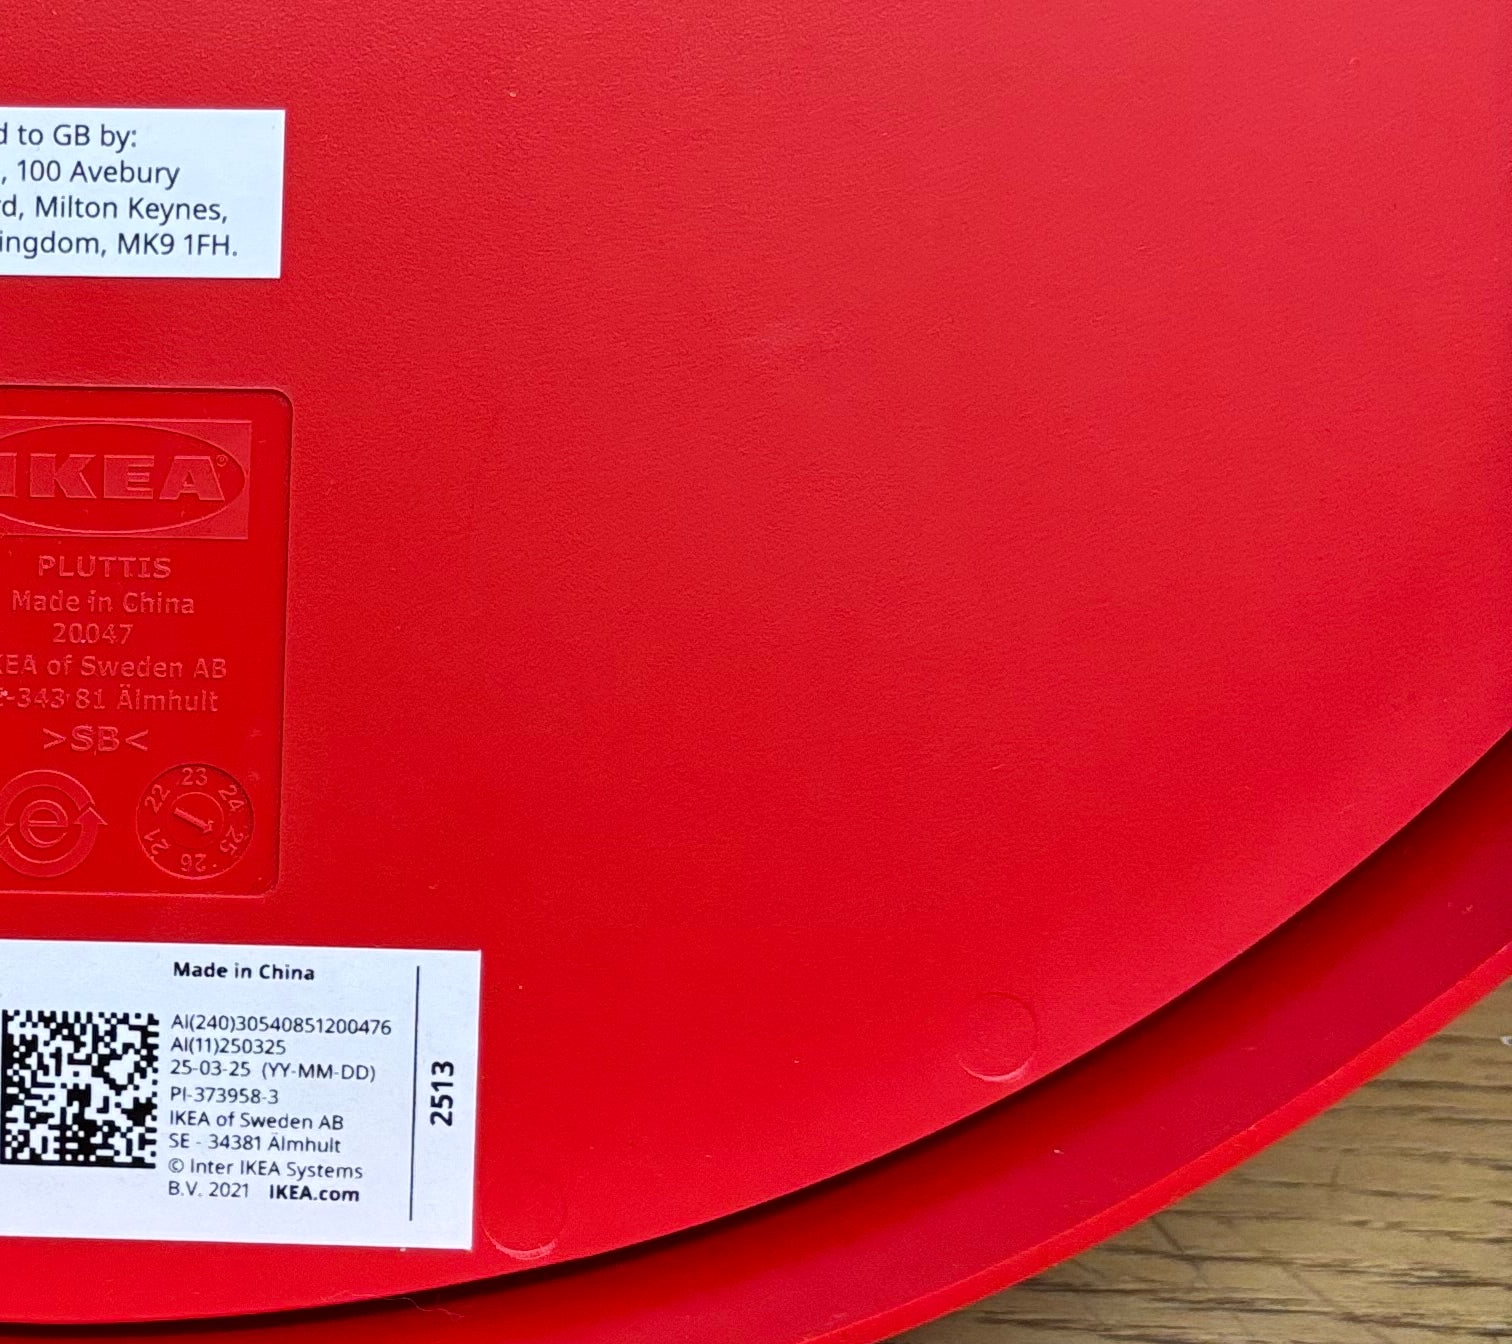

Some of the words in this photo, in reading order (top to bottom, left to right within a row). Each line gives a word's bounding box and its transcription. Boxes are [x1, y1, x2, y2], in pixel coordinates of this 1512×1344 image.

[18, 126, 44, 146] to
[53, 124, 91, 146] GB
[101, 123, 137, 153] by:
[17, 160, 61, 182] 100
[69, 159, 180, 190] Avebury
[35, 194, 117, 219] Milton
[129, 197, 228, 226] Keynes,
[118, 232, 174, 255] MK9
[185, 233, 238, 256] 1FH.
[38, 555, 172, 578] PLUTTIS
[11, 590, 80, 612] Made
[87, 591, 113, 613] in
[123, 592, 194, 614] China
[52, 623, 133, 644] 20047
[46, 655, 73, 676] of
[80, 656, 183, 677] Sweden
[193, 658, 227, 679] AB
[76, 690, 104, 709] 81
[116, 685, 218, 712] Älmhult
[173, 962, 227, 978] Made
[235, 963, 252, 978] in
[259, 964, 315, 981] China
[171, 1014, 392, 1036] AI(240)30540851200476
[171, 1037, 287, 1055] AI(11)250325
[170, 1060, 251, 1077] 25-03-25
[262, 1062, 376, 1082] (YY-MM-DD)
[171, 1087, 279, 1104] PI-373958-3
[430, 1061, 454, 1126] 2513
[170, 1111, 210, 1126] IKEA
[216, 1112, 235, 1127] of
[240, 1113, 312, 1129] Sweden
[319, 1115, 343, 1130] AB
[169, 1134, 190, 1149] SE
[208, 1134, 261, 1150] 34381
[268, 1132, 341, 1153] Älmhult
[191, 1159, 233, 1175] Inter
[240, 1160, 280, 1176] IKEA
[287, 1162, 363, 1181] Systems
[169, 1181, 204, 1197] B.V.
[209, 1182, 249, 1198] 2021
[270, 1184, 359, 1202] IKEA.com
